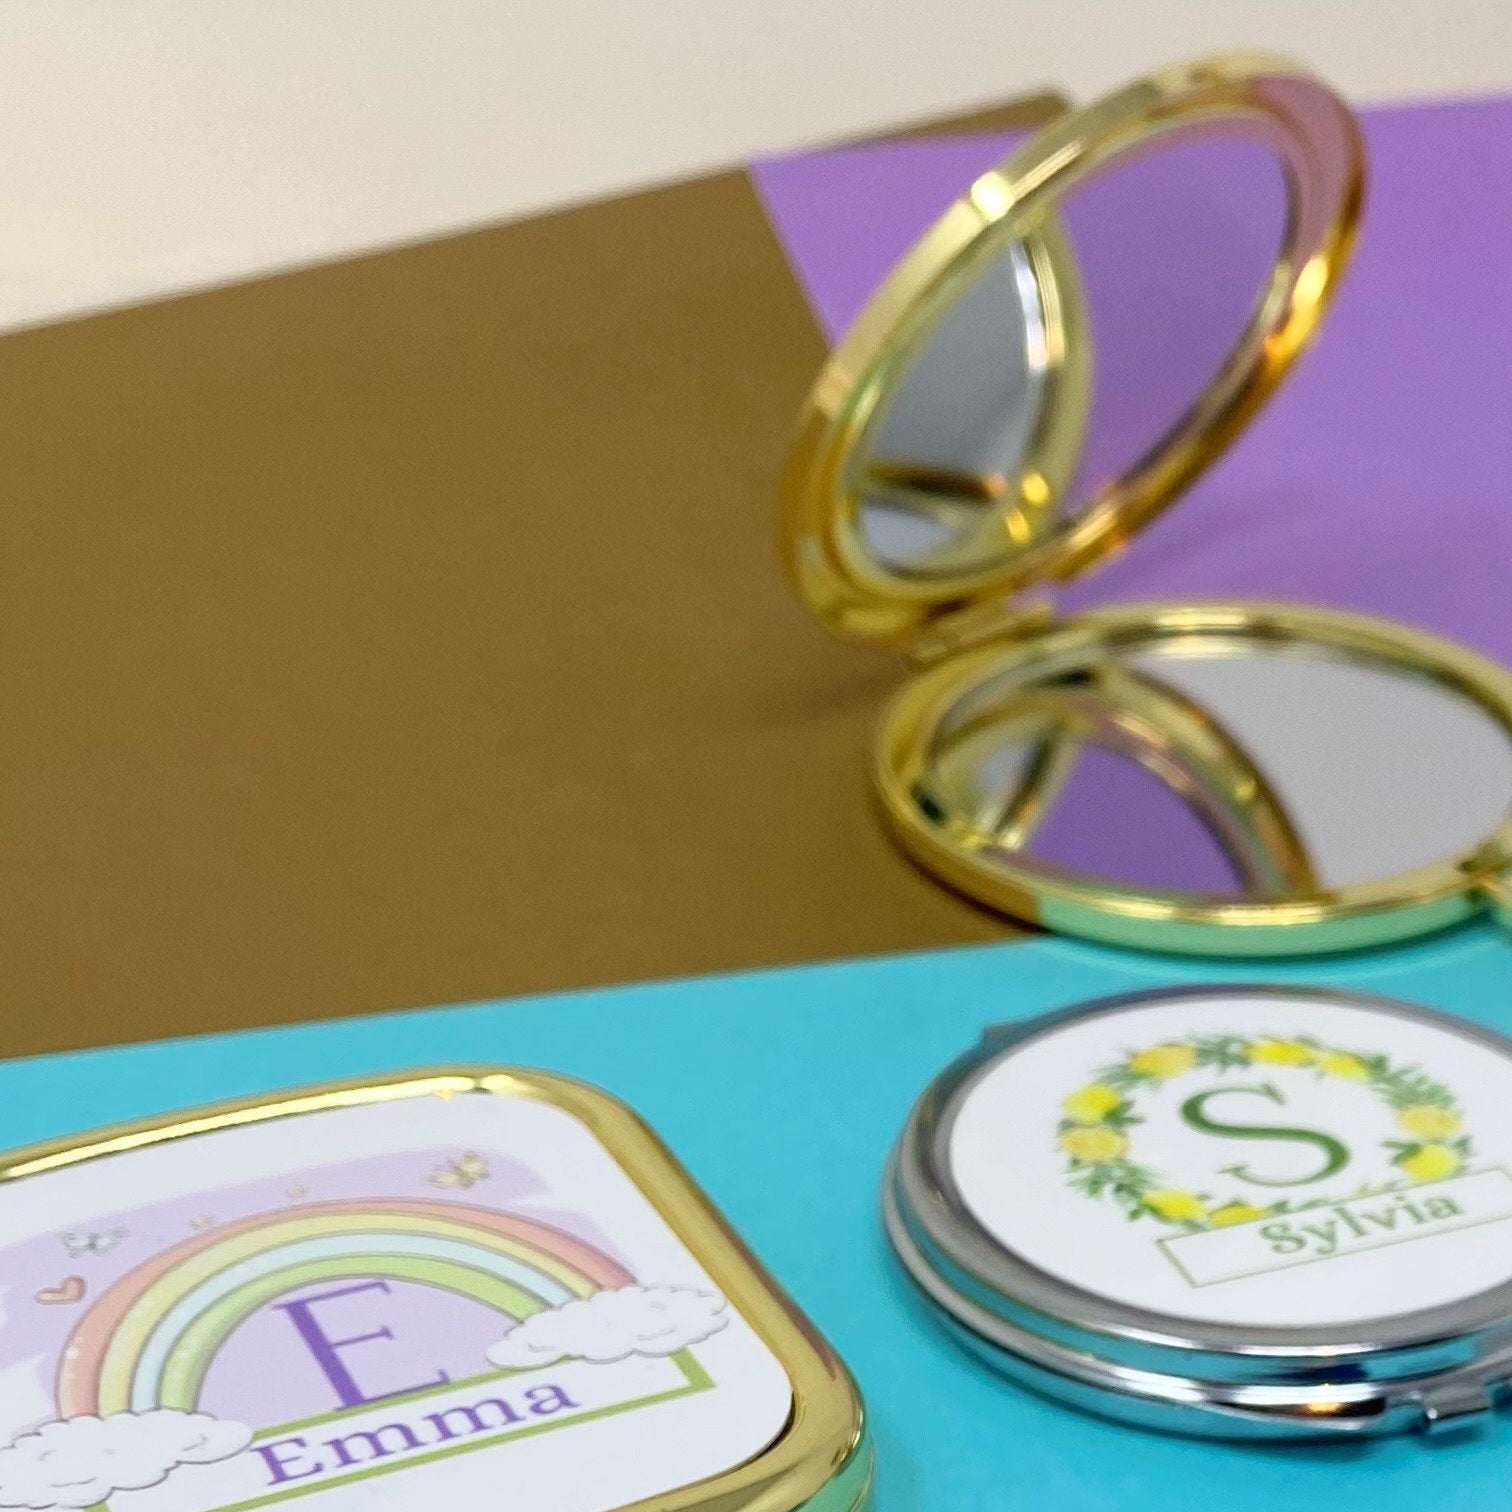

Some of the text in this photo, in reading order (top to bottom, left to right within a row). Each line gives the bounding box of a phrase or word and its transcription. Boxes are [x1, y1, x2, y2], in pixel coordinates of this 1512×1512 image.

[1179, 1081, 1350, 1187] S
[1259, 1193, 1465, 1257] Sylvia
[273, 1278, 451, 1412] E
[248, 1379, 582, 1486] Emma
